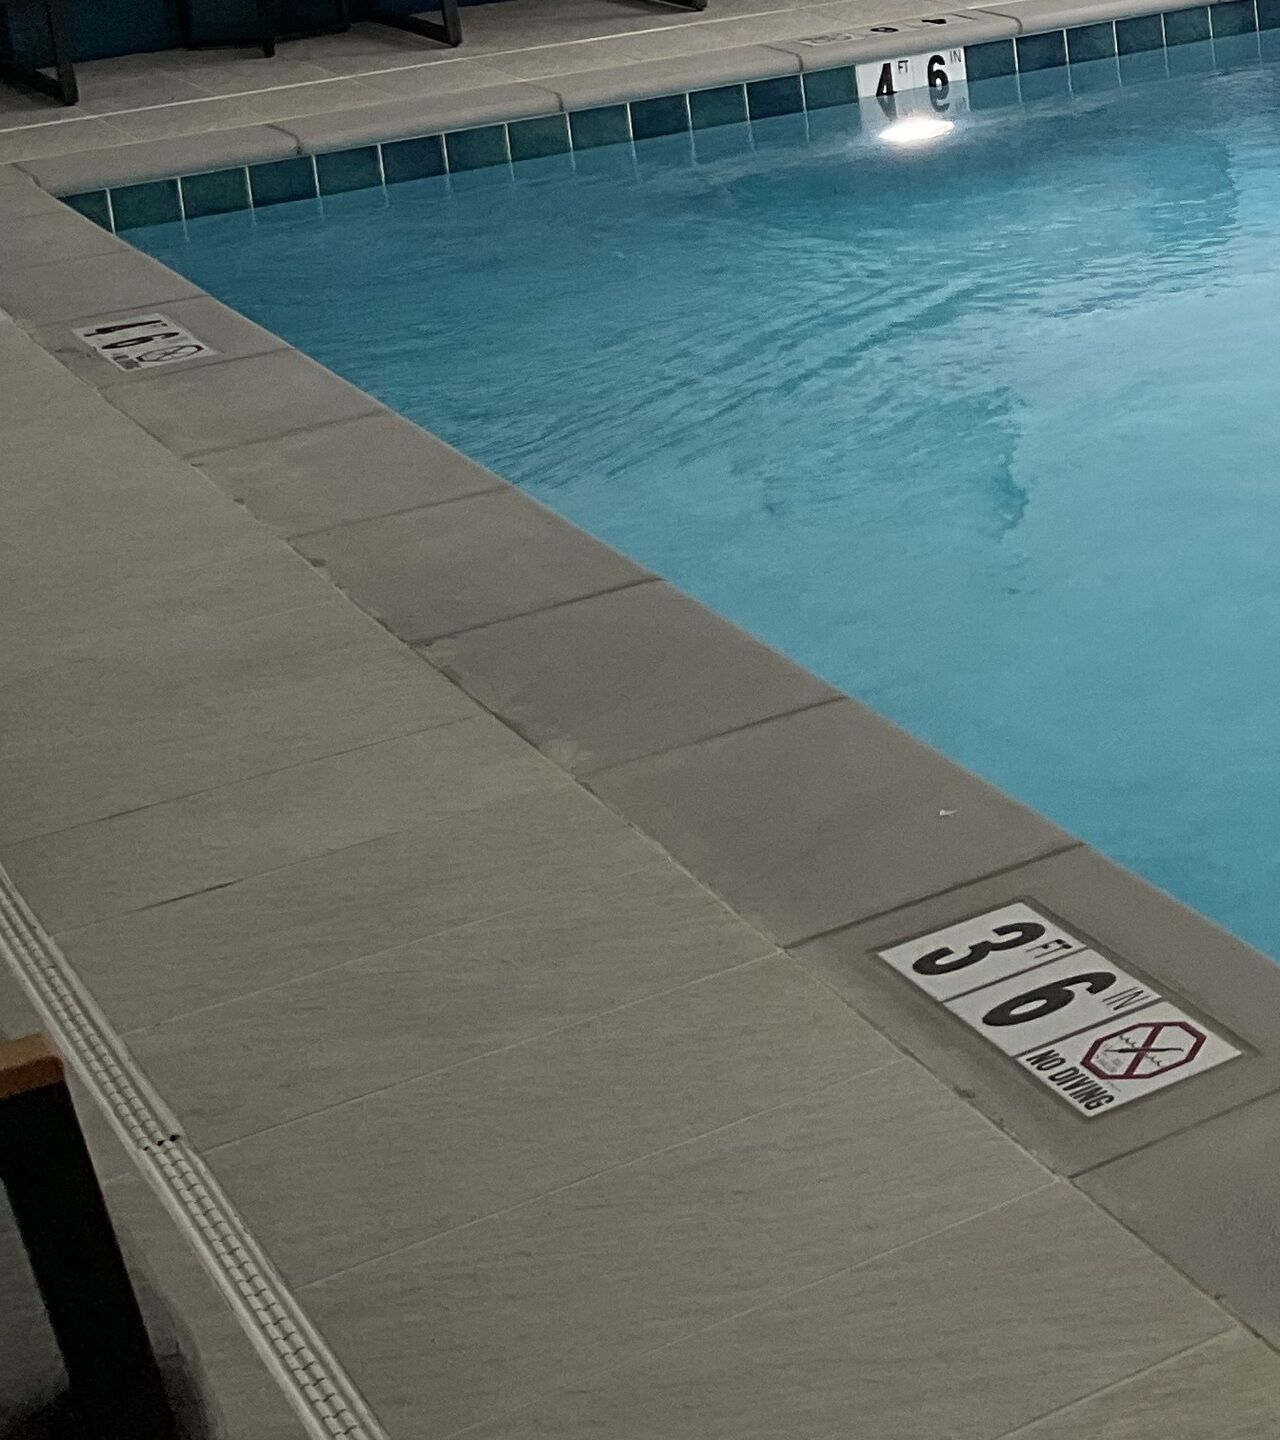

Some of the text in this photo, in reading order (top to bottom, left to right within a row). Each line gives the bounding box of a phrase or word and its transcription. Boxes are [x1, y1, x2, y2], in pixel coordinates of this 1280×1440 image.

[876, 50, 962, 96] 4 FT 6 IN
[912, 922, 1154, 1026] 3 FT 6 IN
[1026, 1049, 1115, 1110] NO DIVING
